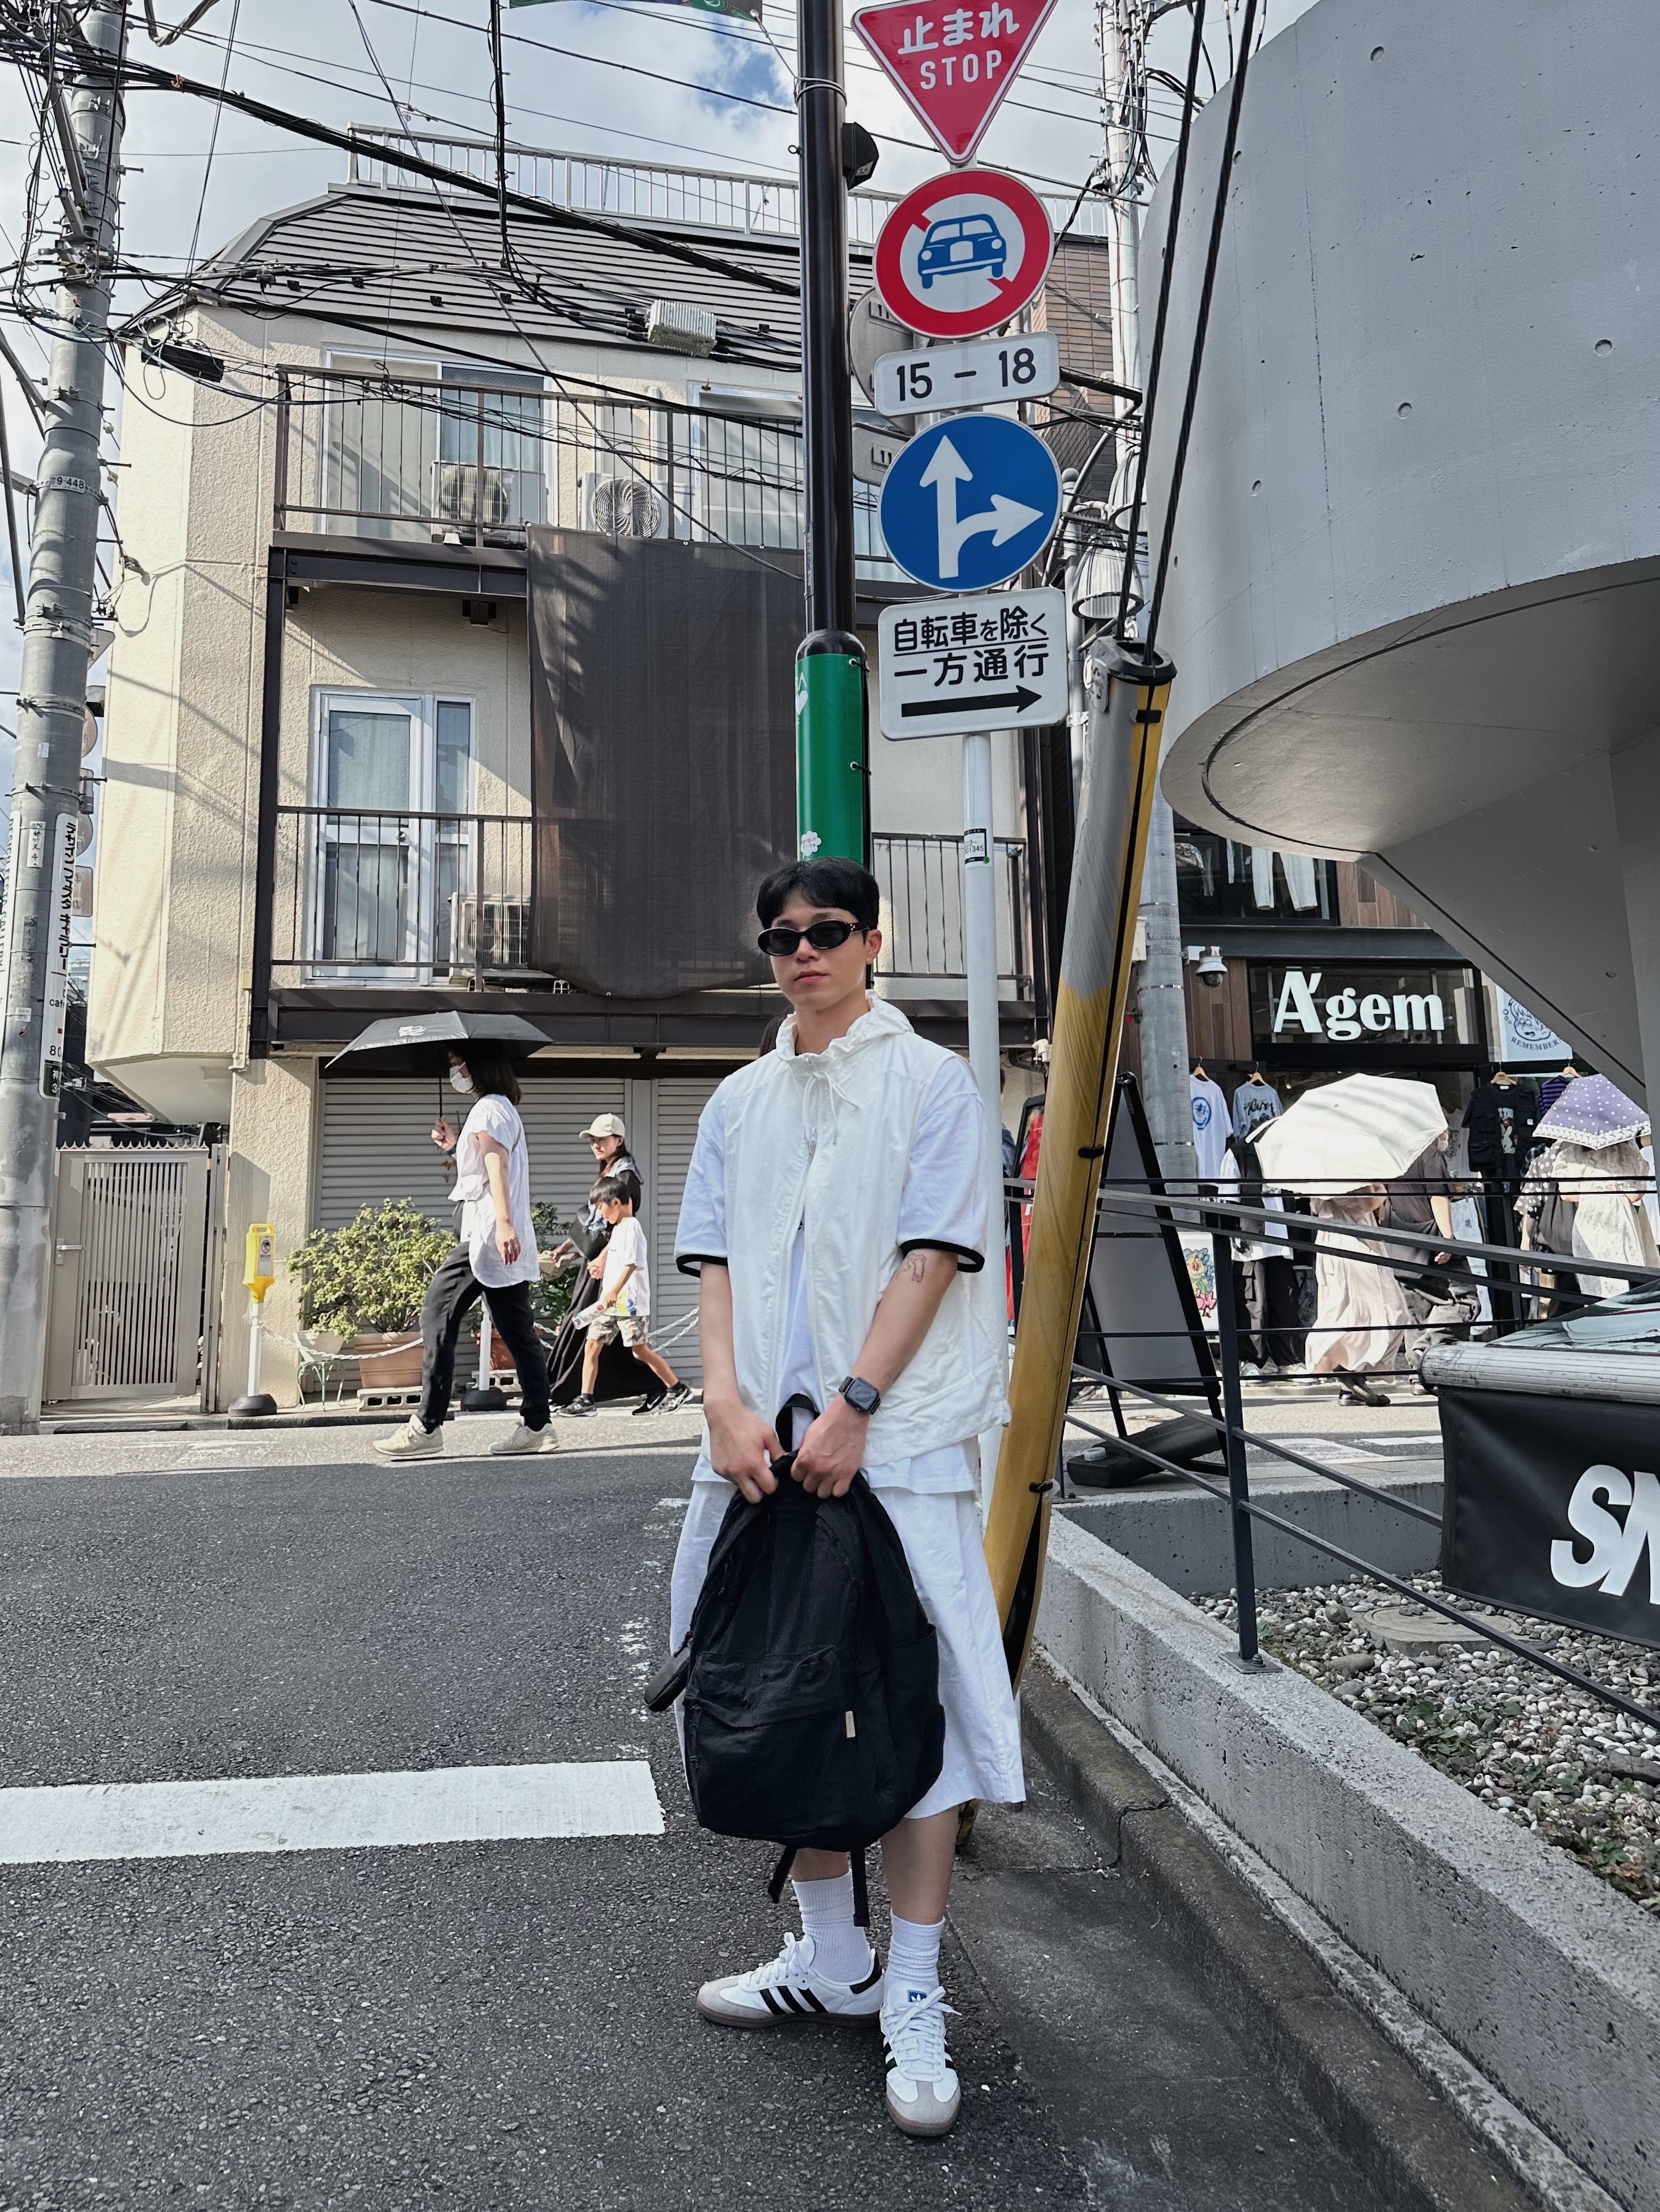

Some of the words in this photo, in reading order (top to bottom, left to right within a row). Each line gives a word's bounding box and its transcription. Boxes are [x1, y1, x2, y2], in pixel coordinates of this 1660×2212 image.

[898, 2, 1020, 55] 止まれ
[920, 50, 1002, 90] STOP
[896, 362, 932, 401] 15
[999, 348, 1036, 387] 18
[895, 606, 1047, 652] 自転車を除く
[894, 643, 1049, 687] 一方通行
